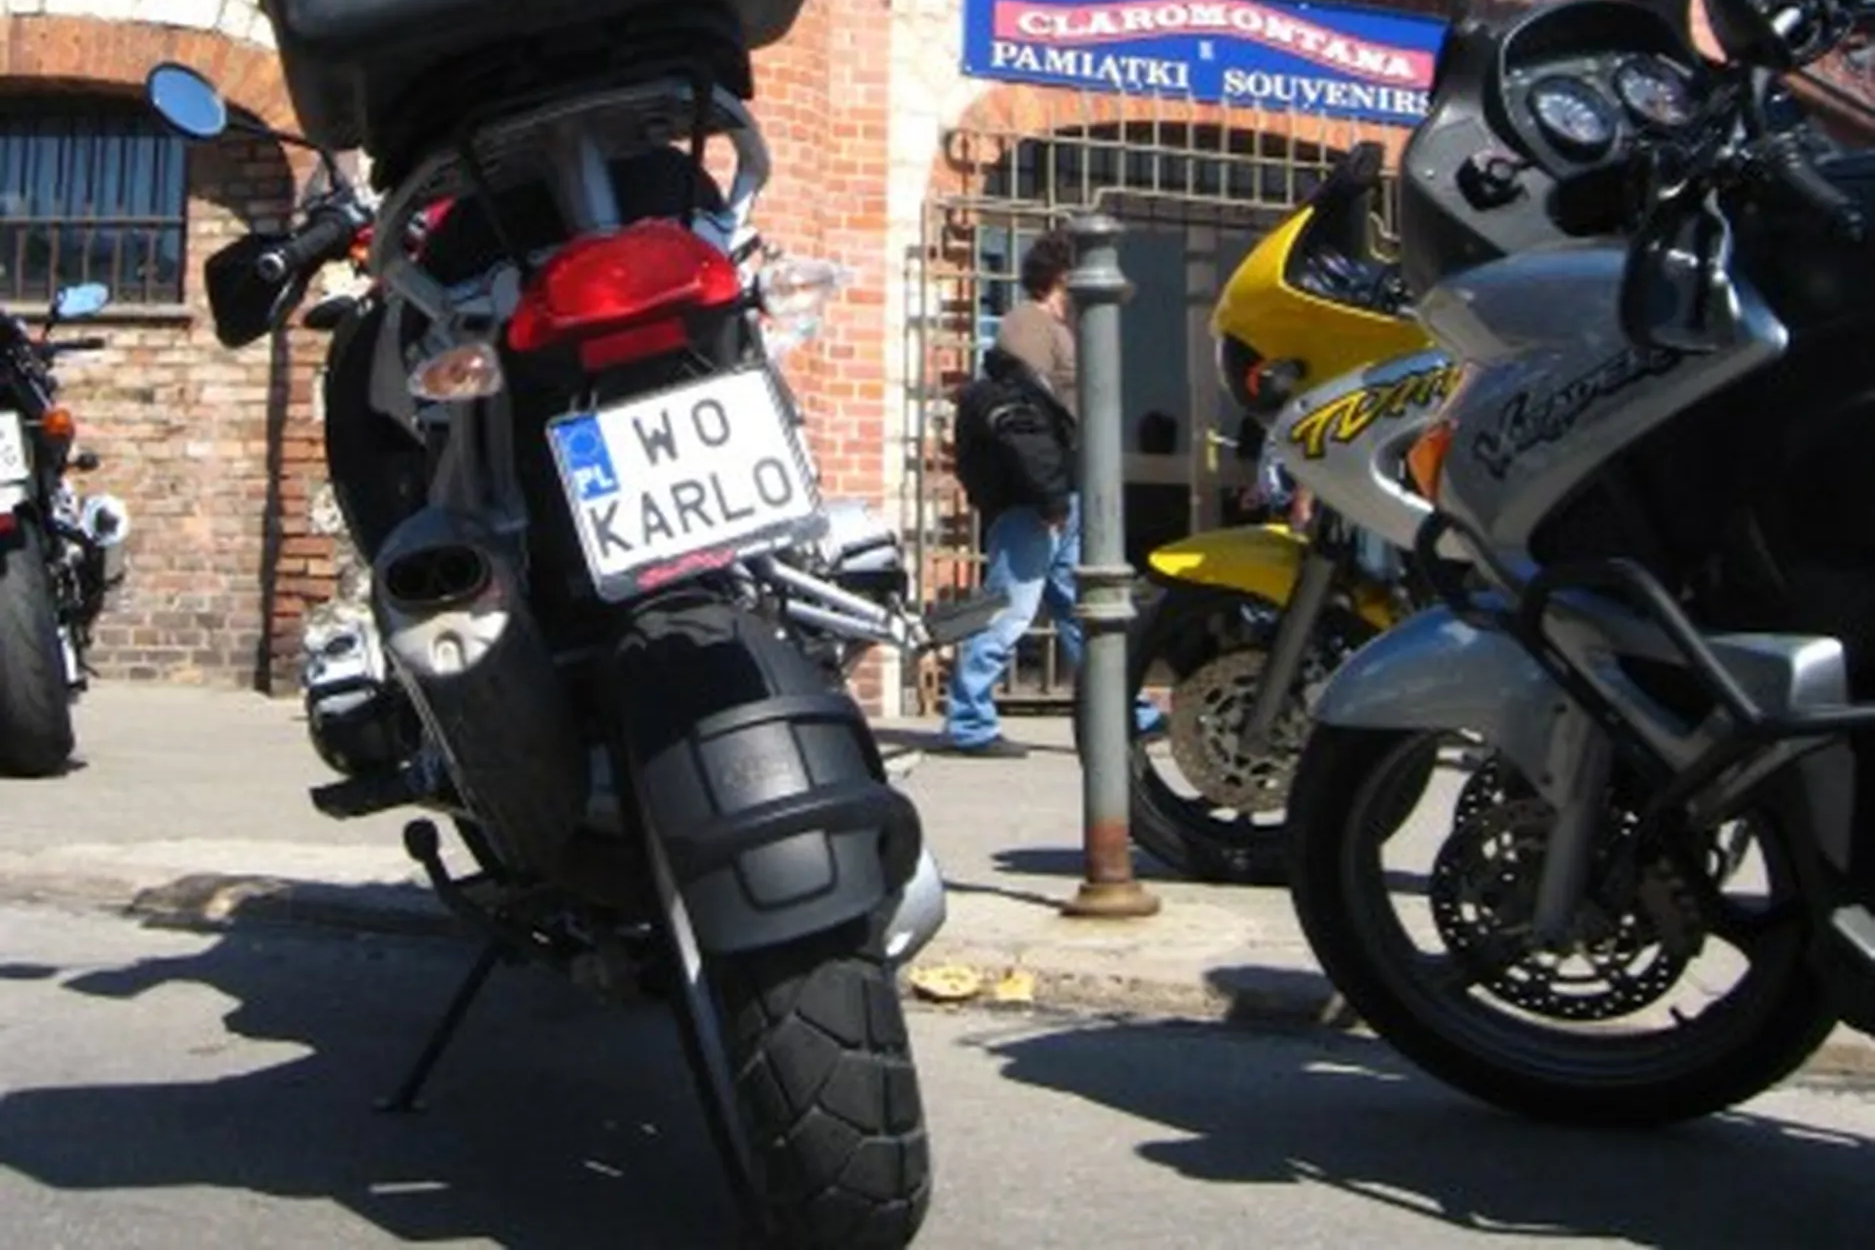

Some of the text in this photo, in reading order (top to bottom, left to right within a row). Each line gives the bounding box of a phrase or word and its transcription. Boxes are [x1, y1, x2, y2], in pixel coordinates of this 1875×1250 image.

[1018, 2, 1415, 78] CLAROMONTANA
[573, 464, 615, 495] PL
[589, 456, 793, 559] KARLO
